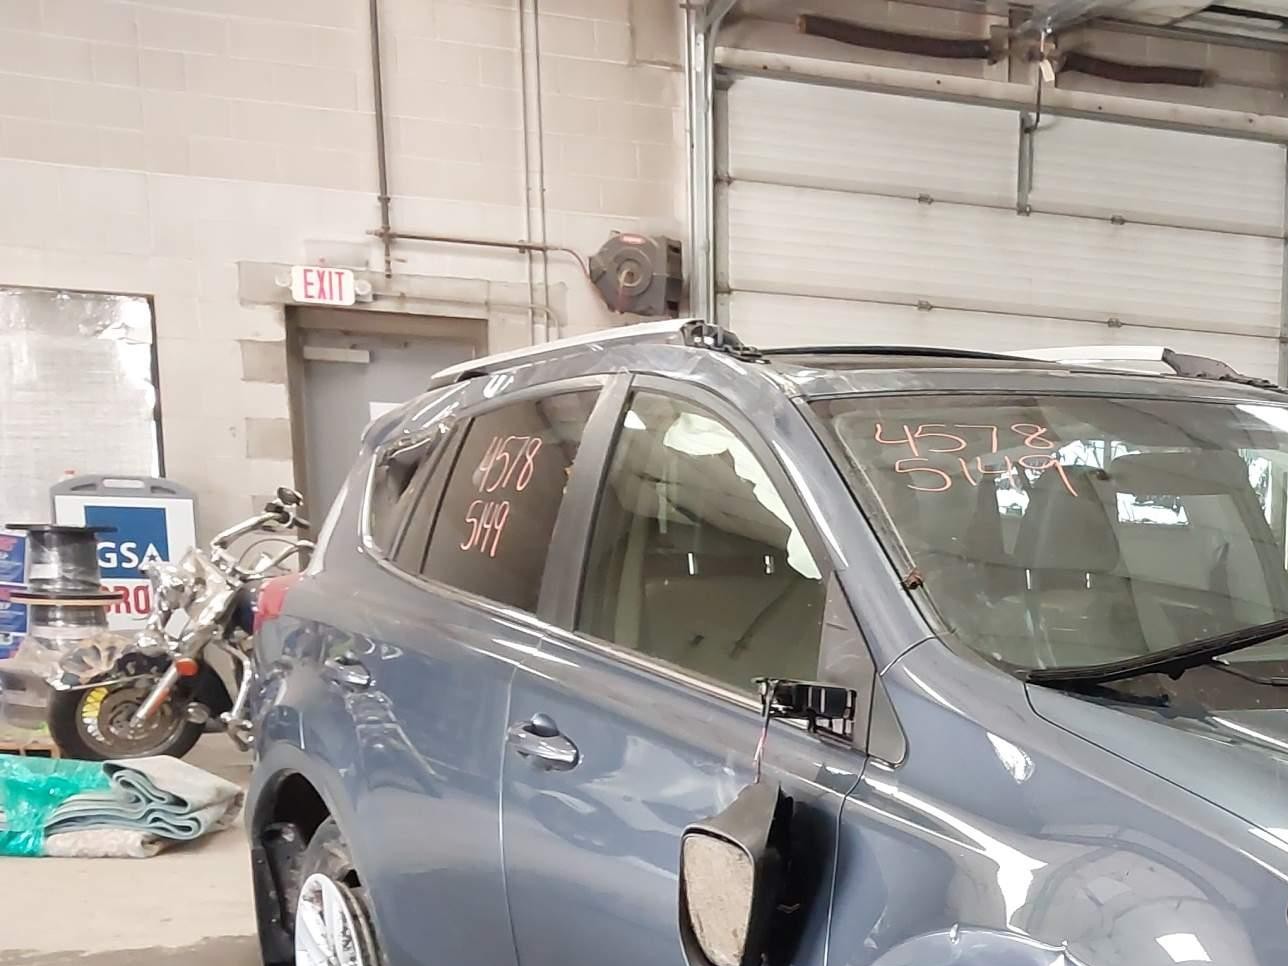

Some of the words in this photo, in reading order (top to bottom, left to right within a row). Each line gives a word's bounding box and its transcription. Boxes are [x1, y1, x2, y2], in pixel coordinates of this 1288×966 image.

[303, 268, 345, 301] EXIT
[874, 423, 1055, 457] 4578
[479, 435, 543, 492] 4578
[894, 454, 1078, 497] 5149
[460, 499, 510, 557] 5149
[97, 541, 163, 571] GSA
[101, 584, 151, 615] RO
